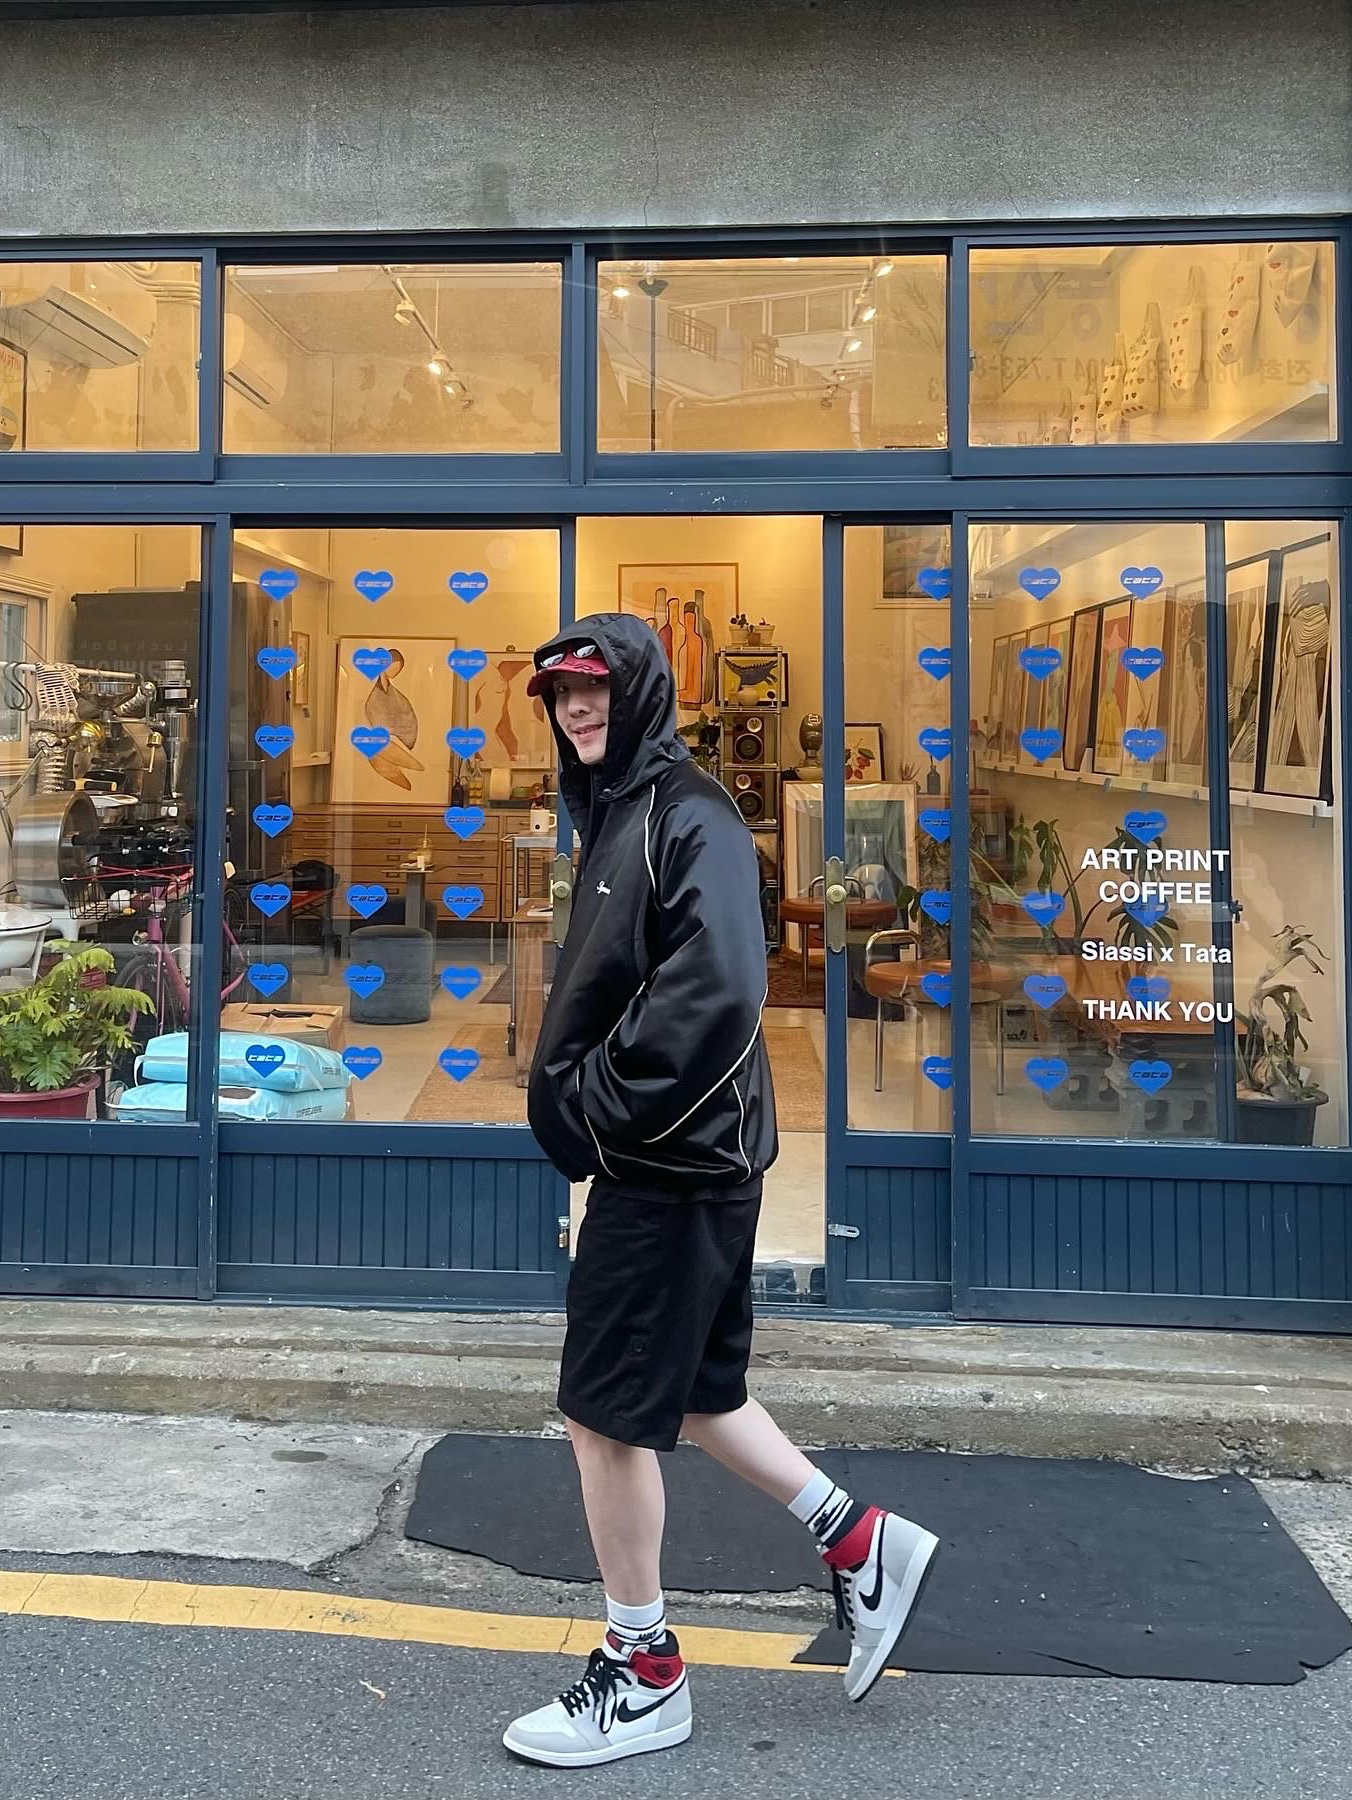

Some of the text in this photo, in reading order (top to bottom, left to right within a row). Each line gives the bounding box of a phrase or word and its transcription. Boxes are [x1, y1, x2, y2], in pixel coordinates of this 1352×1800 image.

[1080, 848, 1230, 872] ART PRINT
[1099, 881, 1212, 904] COFFEE
[1081, 940, 1232, 964] Siassi x Tata
[1083, 999, 1234, 1023] THANK YOU
